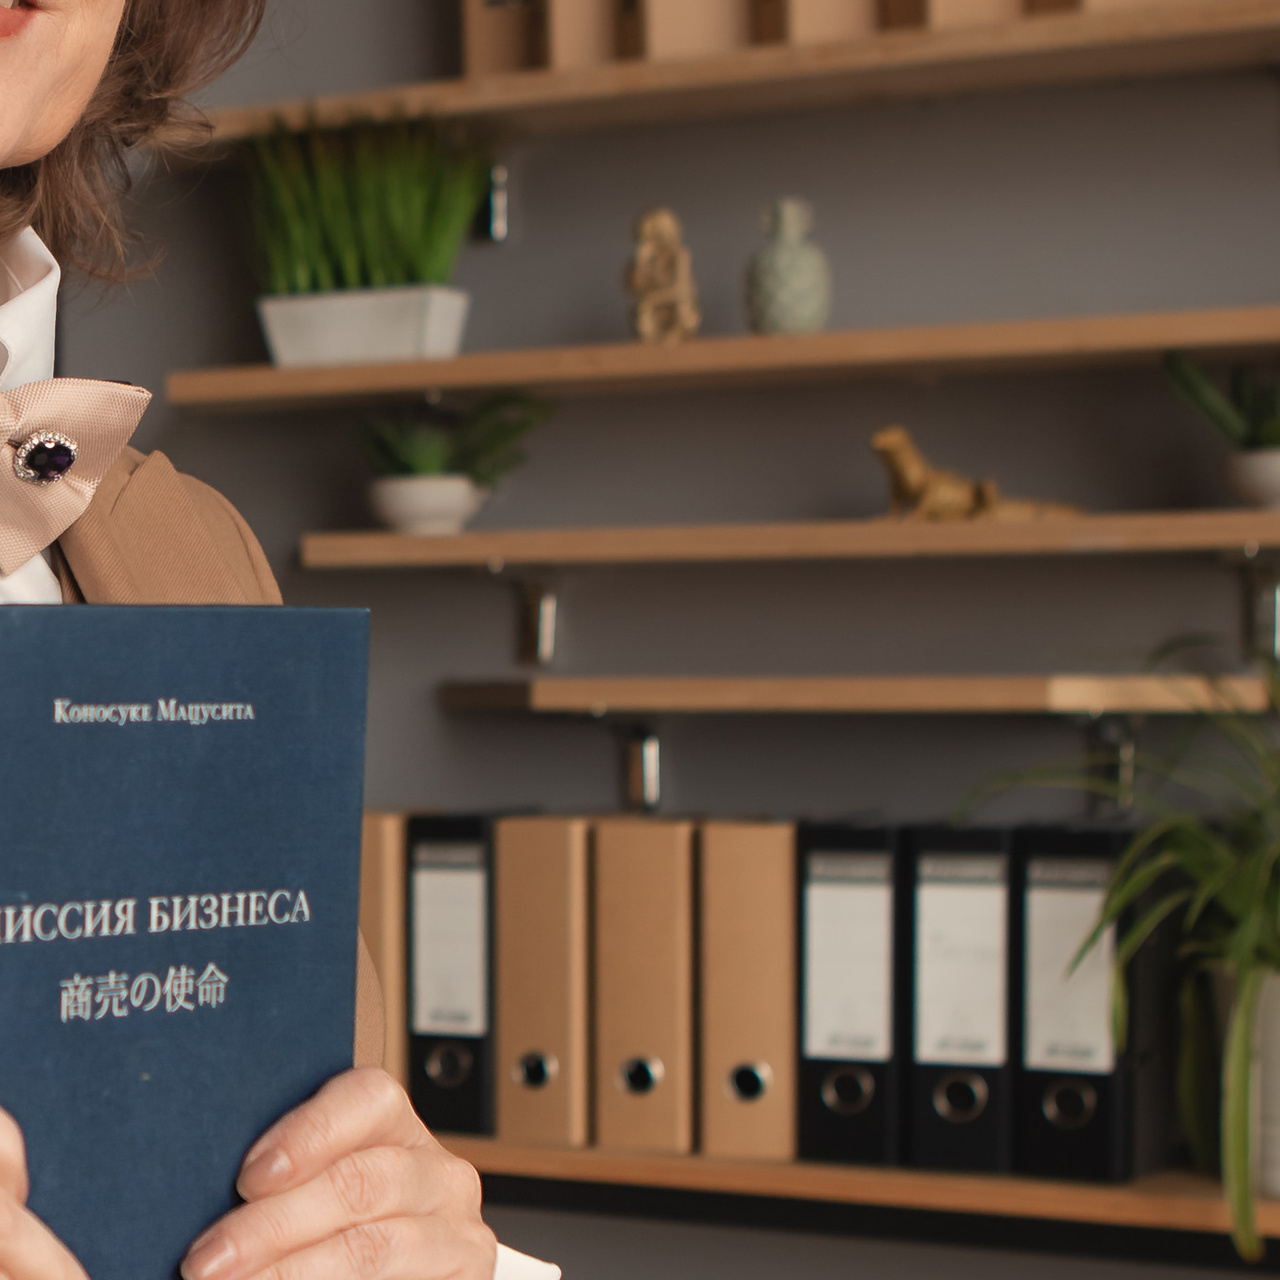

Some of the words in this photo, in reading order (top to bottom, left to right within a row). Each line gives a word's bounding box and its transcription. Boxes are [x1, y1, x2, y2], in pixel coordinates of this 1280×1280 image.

[147, 889, 311, 934] БИЗНЕСА
[59, 961, 230, 1023] 商売の使命
